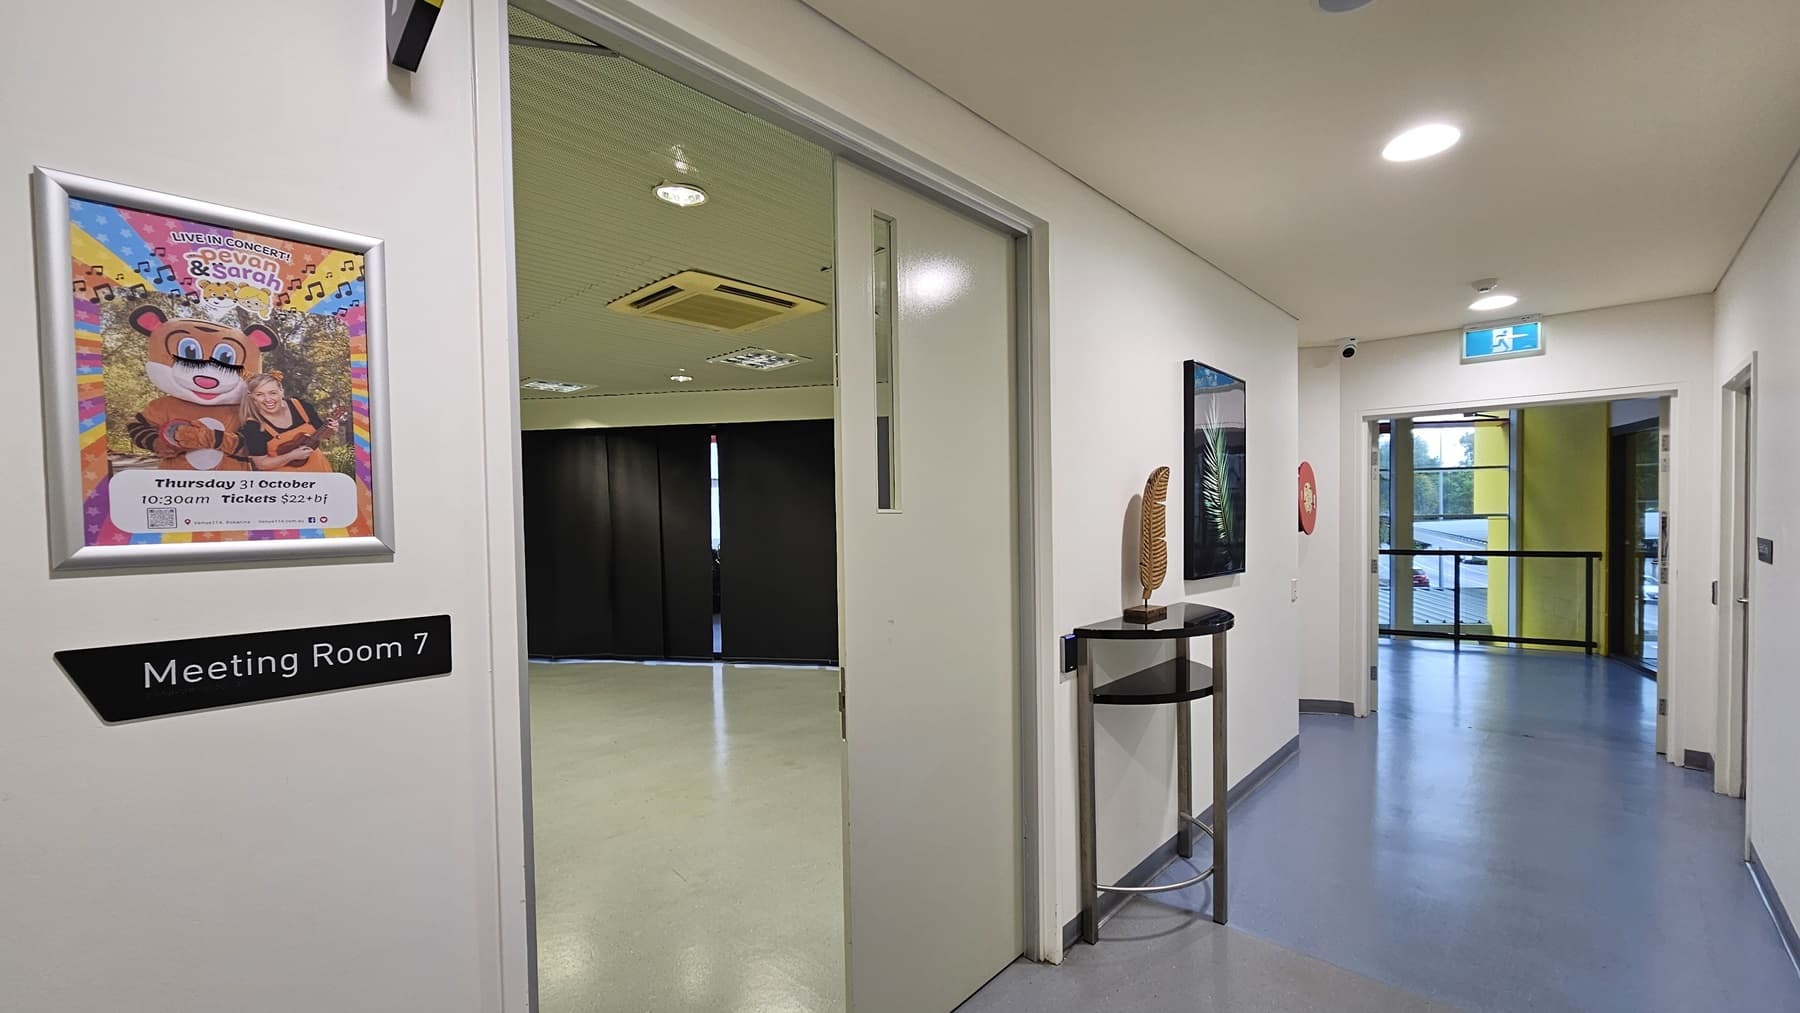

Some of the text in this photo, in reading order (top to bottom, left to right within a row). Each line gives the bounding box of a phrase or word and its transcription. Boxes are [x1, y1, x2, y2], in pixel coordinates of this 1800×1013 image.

[172, 233, 290, 261] LIVE IN CONCERT!
[190, 260, 281, 291] & Sarah
[155, 479, 316, 490] Thursday 31 October
[142, 493, 328, 506] 10:30am Tickets $22+bf
[143, 632, 429, 688] Meeting Room 7
